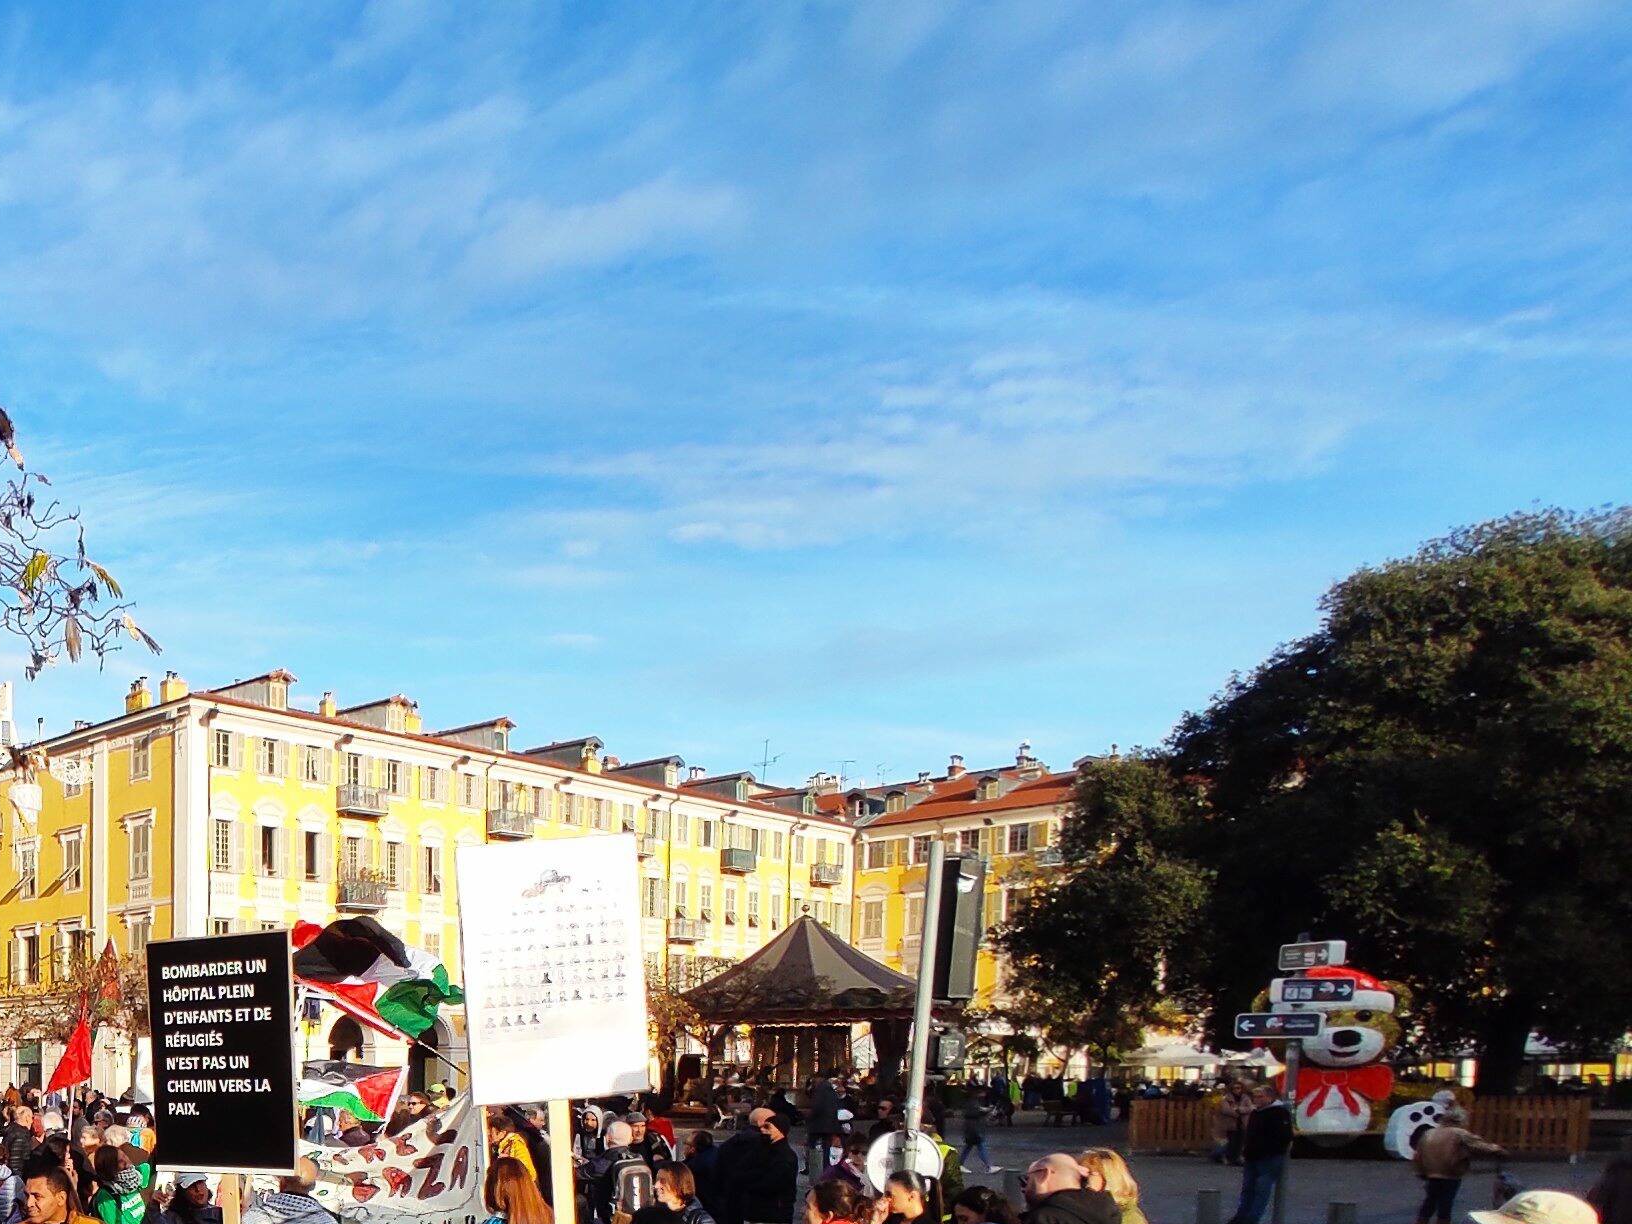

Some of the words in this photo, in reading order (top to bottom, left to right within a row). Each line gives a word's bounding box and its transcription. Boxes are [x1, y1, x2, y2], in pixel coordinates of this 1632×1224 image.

[162, 961, 242, 979] BOMBARDER
[245, 959, 267, 974] UN
[163, 986, 216, 1003] HÔPITAL
[218, 984, 255, 999] PLEIN
[164, 1009, 232, 1025] D'ENFANTS
[235, 1008, 252, 1022] ET
[253, 1007, 272, 1021] DE
[165, 1030, 224, 1047] RÉFUGIÉS
[166, 1057, 199, 1071] N'EST
[202, 1056, 226, 1070] PAS
[229, 1056, 249, 1069] UN
[167, 1080, 216, 1094] CHEMIN
[219, 1079, 252, 1093] VERS
[254, 1078, 271, 1092] LA
[168, 1102, 200, 1116] PAIX.
